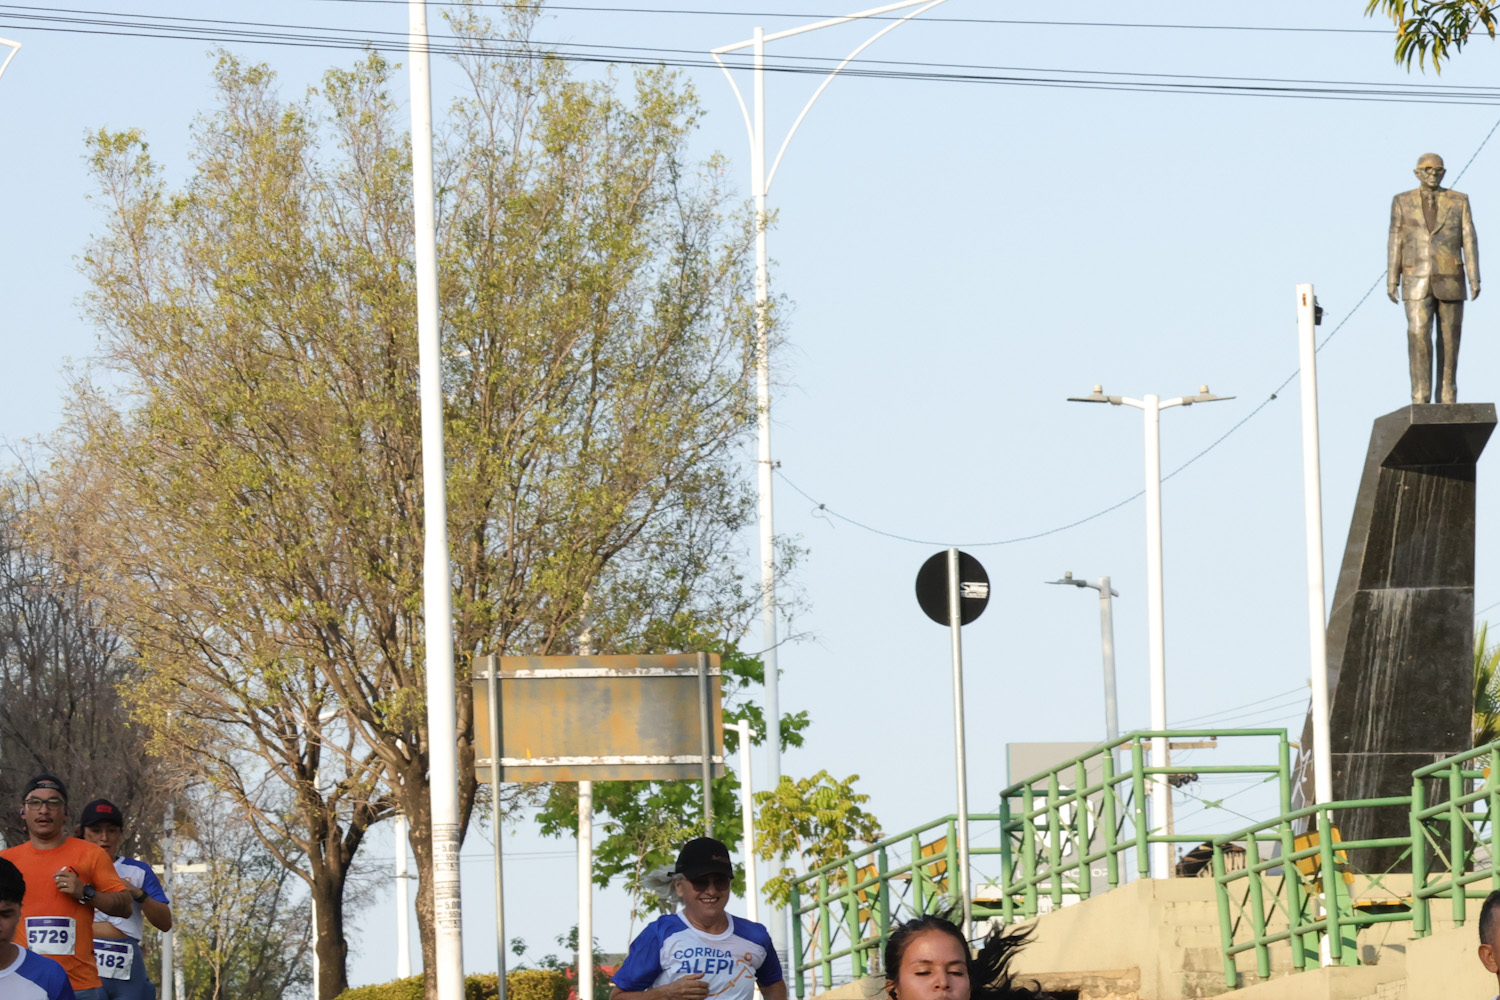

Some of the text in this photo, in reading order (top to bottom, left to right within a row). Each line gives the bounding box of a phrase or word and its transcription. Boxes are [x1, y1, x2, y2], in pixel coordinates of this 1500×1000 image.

[28, 929, 69, 944] 5729
[674, 947, 732, 960] CORRIDA
[677, 957, 734, 975] ALEPI
